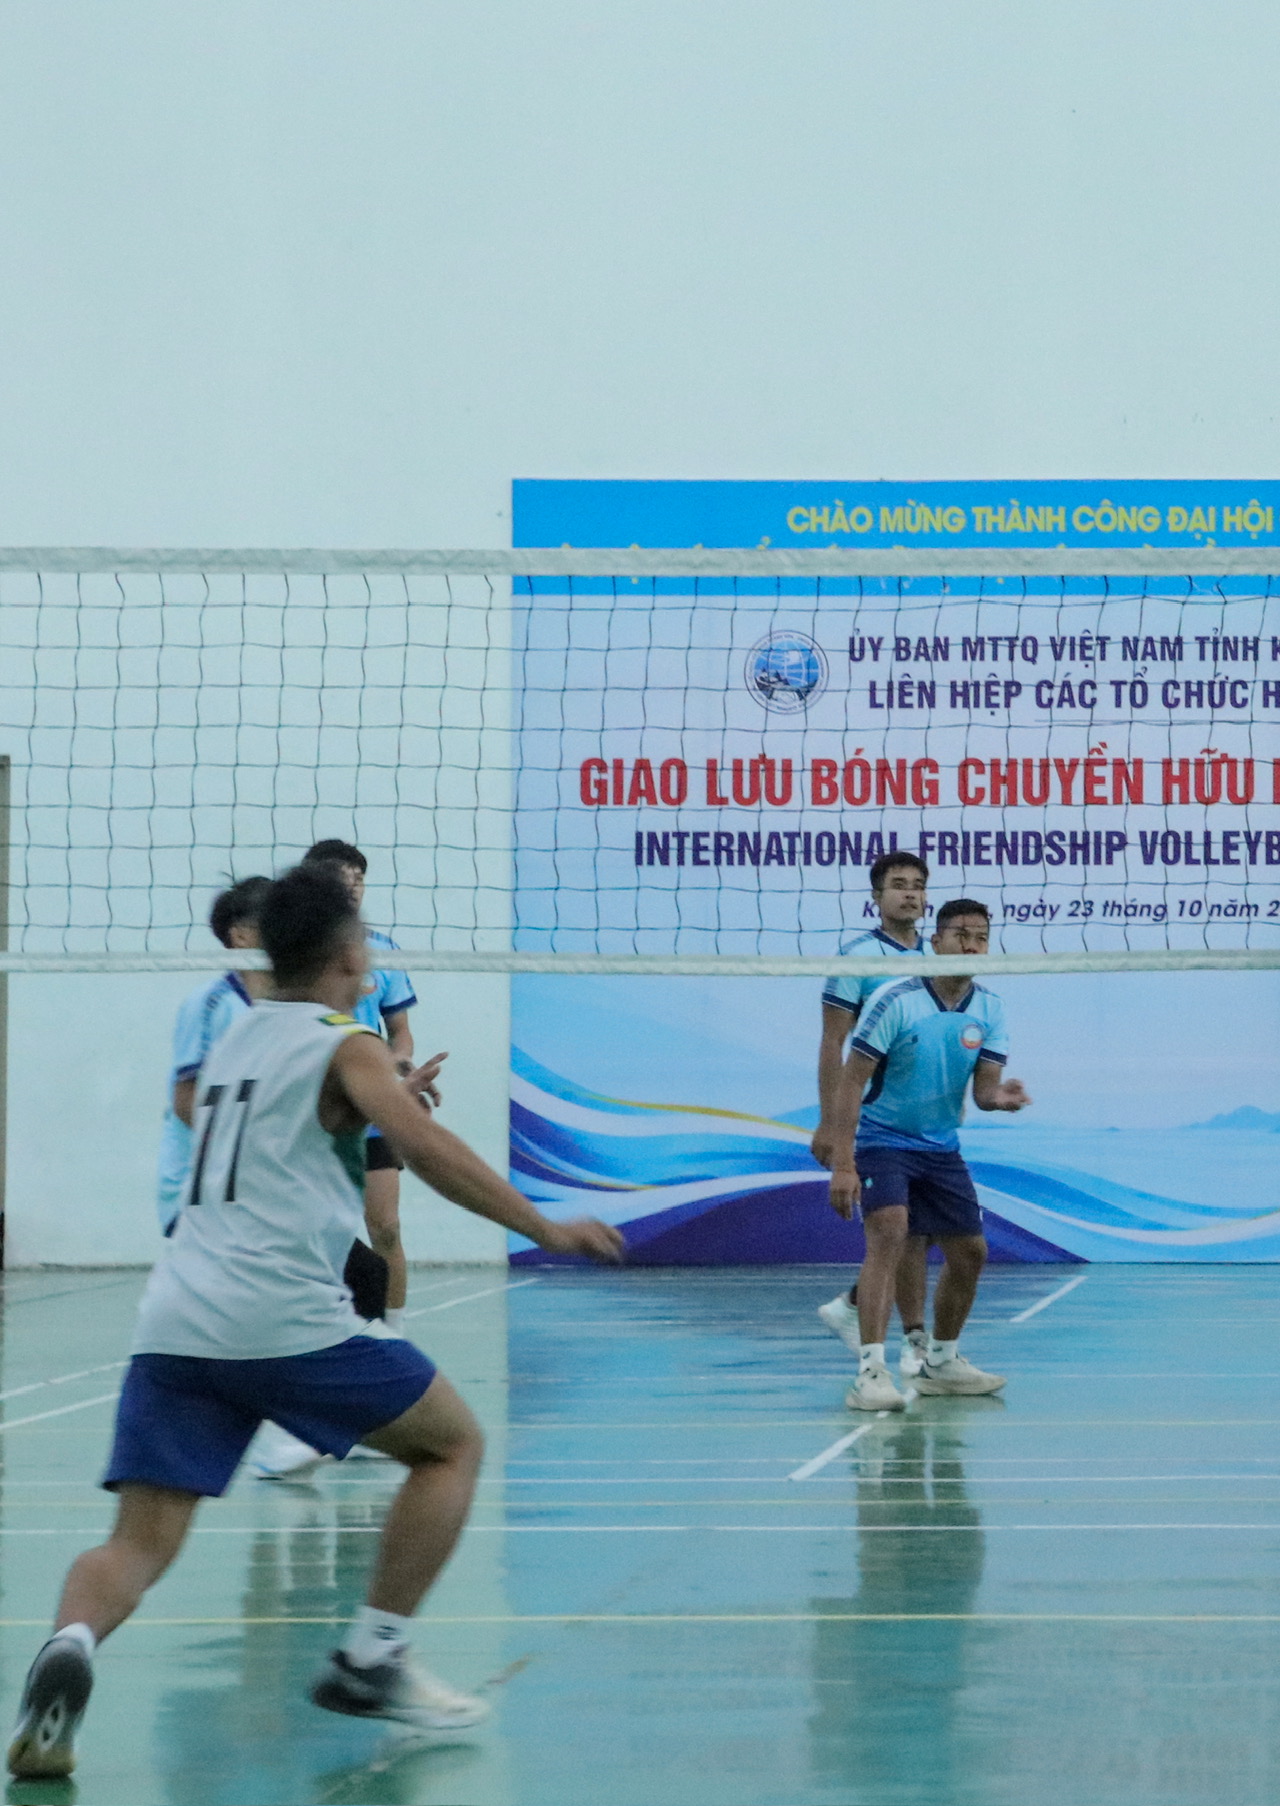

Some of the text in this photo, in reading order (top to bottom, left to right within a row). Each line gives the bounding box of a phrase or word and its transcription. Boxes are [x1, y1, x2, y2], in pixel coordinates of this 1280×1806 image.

[787, 499, 873, 533] CHÀO
[880, 499, 967, 533] MỪNG
[972, 499, 1067, 533] THÀNH
[1072, 499, 1162, 533] CÔNG
[1167, 506, 1217, 540] ĐẠI
[1223, 499, 1274, 540] HỘI
[849, 628, 884, 662] ỦY
[895, 636, 949, 662] BAN
[962, 636, 1039, 665] MTTQ
[1050, 629, 1111, 668] VIỆT
[1122, 636, 1183, 661] NAM
[1195, 627, 1259, 661] TỈNH
[869, 673, 936, 709] LIÊN
[950, 673, 1022, 716] HIỆP
[1035, 672, 1098, 709] CÁC
[1110, 666, 1149, 709] TỔ
[1162, 672, 1249, 709] CHỨC
[580, 757, 688, 806] GIAO
[706, 753, 792, 806] LƯU
[811, 748, 940, 806] BÓNG
[958, 742, 1144, 806] CHUYỀN
[1162, 749, 1255, 805] HỮU
[634, 831, 898, 866] INTERNATIONAL
[919, 831, 1126, 866] FRIENDSHIP
[1003, 899, 1060, 921] ngày
[1068, 901, 1094, 917] 23
[1102, 899, 1167, 922] tháng
[1178, 901, 1201, 917] 10
[1209, 899, 1259, 917] năm
[189, 1079, 258, 1205] 11
